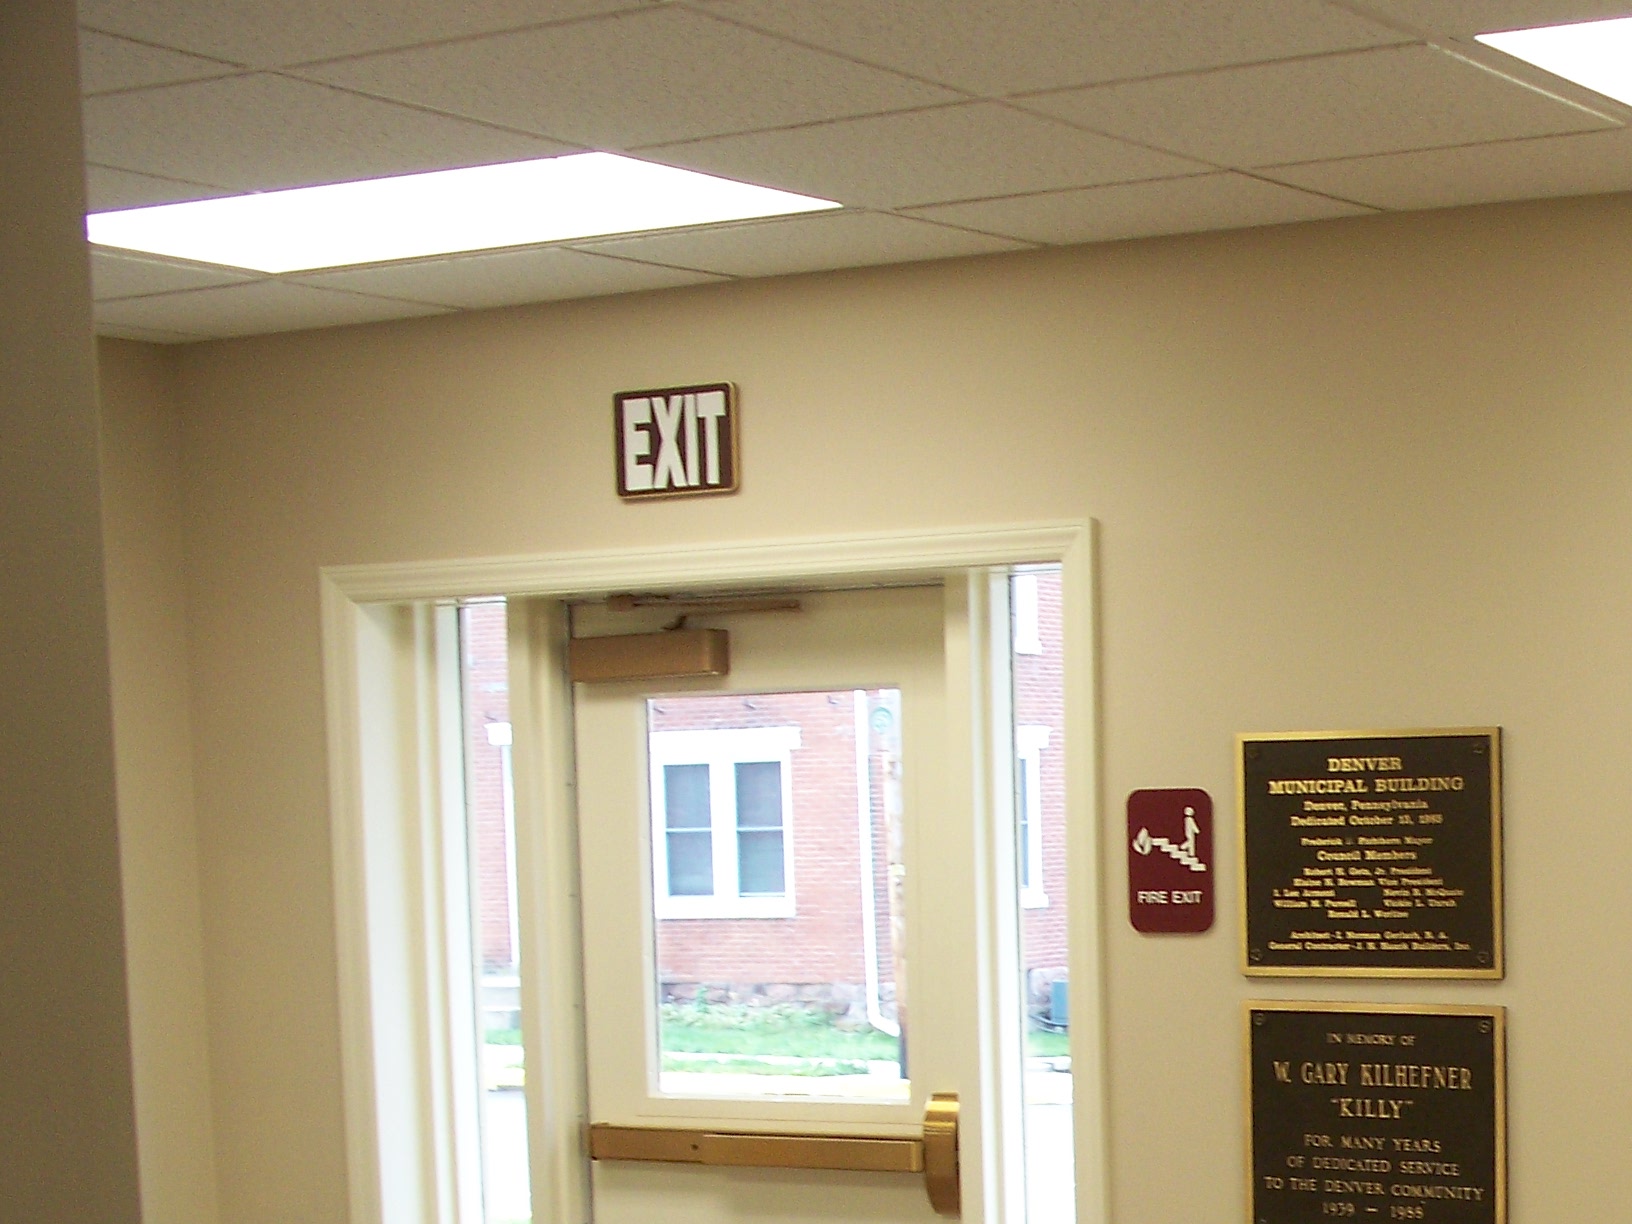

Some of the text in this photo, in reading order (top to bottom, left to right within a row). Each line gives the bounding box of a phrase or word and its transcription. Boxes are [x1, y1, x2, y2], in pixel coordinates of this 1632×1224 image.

[622, 391, 726, 491] EXIT
[1327, 756, 1402, 773] DENVER
[1268, 776, 1465, 795] MUNICIPAL BUILDING
[1303, 799, 1429, 811] Denver, Pennsylvania
[1290, 816, 1346, 827] Dedicated
[1349, 815, 1393, 826] October
[1317, 849, 1417, 861] Council Members
[1137, 890, 1202, 904] FIRE EXIT
[1326, 1032, 1416, 1046] IN MEMORY OF
[1273, 1060, 1473, 1091] W. GARY KILHEFNER
[1303, 1133, 1442, 1154] FOR MANY YEARS
[1286, 1154, 1460, 1177] OF DEDICATED SERVICE
[1263, 1175, 1485, 1201] TO THE DENVER COMMUNITY
